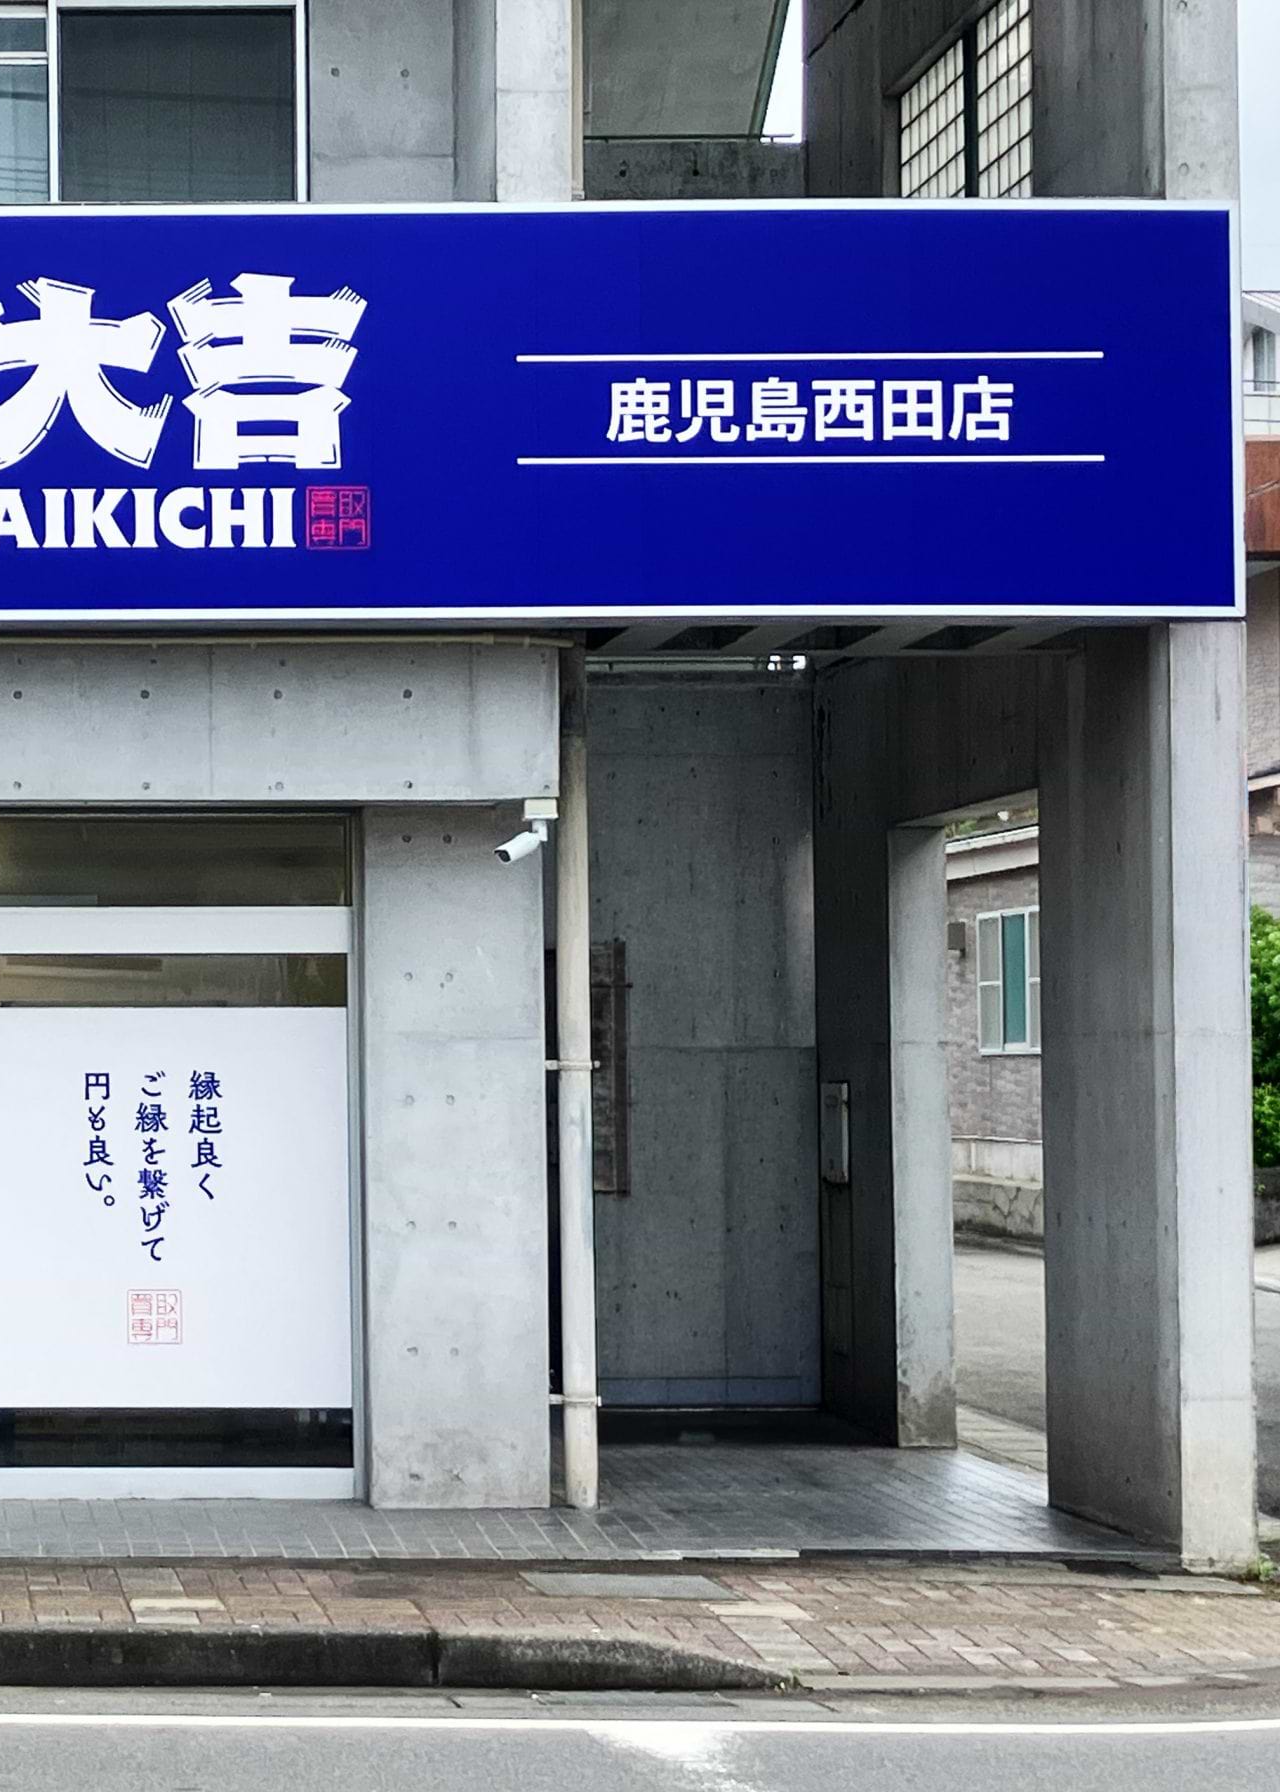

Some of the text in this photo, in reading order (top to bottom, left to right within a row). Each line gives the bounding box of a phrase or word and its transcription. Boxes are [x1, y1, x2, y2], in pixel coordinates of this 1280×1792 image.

[606, 375, 1014, 443] 鹿児島西田店
[82, 1072, 116, 1207] 円も良い。
[134, 1069, 170, 1262] ご縁を繋げて
[188, 1069, 224, 1201] 縁起良く
